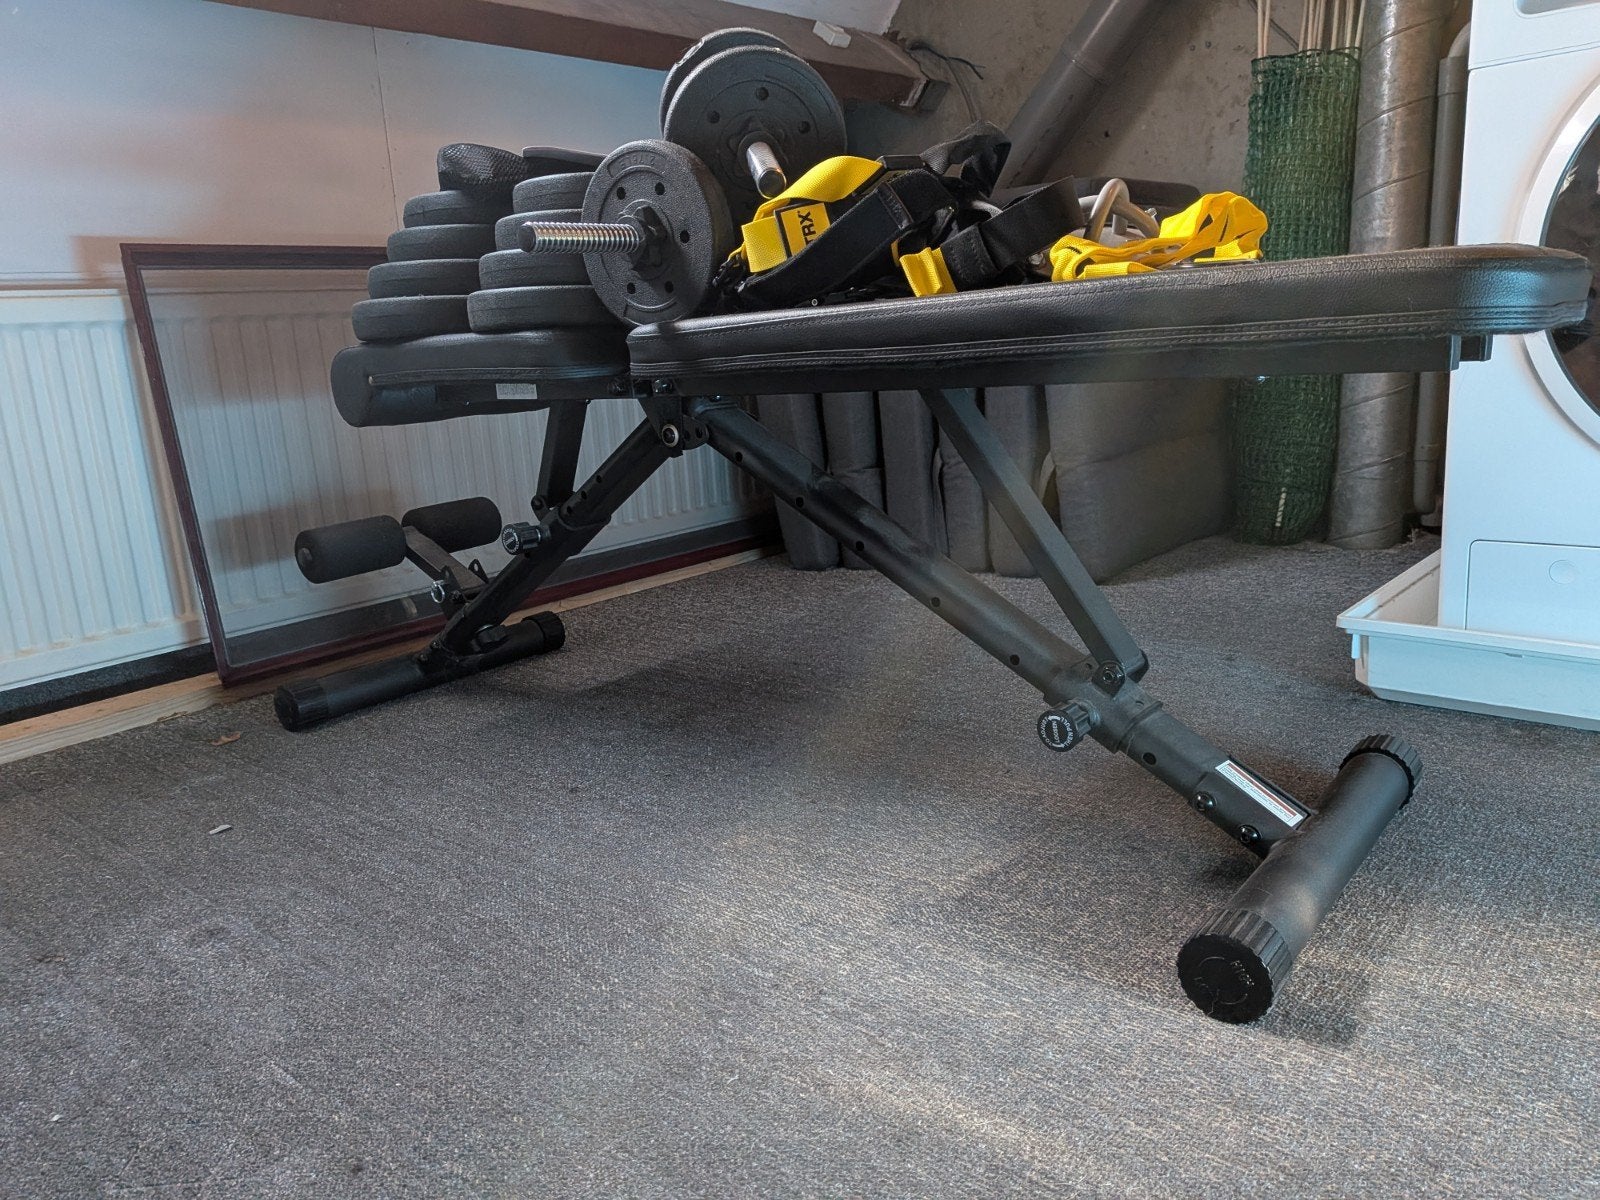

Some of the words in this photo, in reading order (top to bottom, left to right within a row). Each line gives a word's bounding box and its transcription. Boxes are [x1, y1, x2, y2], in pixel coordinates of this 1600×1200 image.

[1040, 716, 1049, 738] ADJUST
[1052, 720, 1060, 743] LOOSEN
[1060, 716, 1073, 732] PULL
[1063, 731, 1074, 747] THEN
